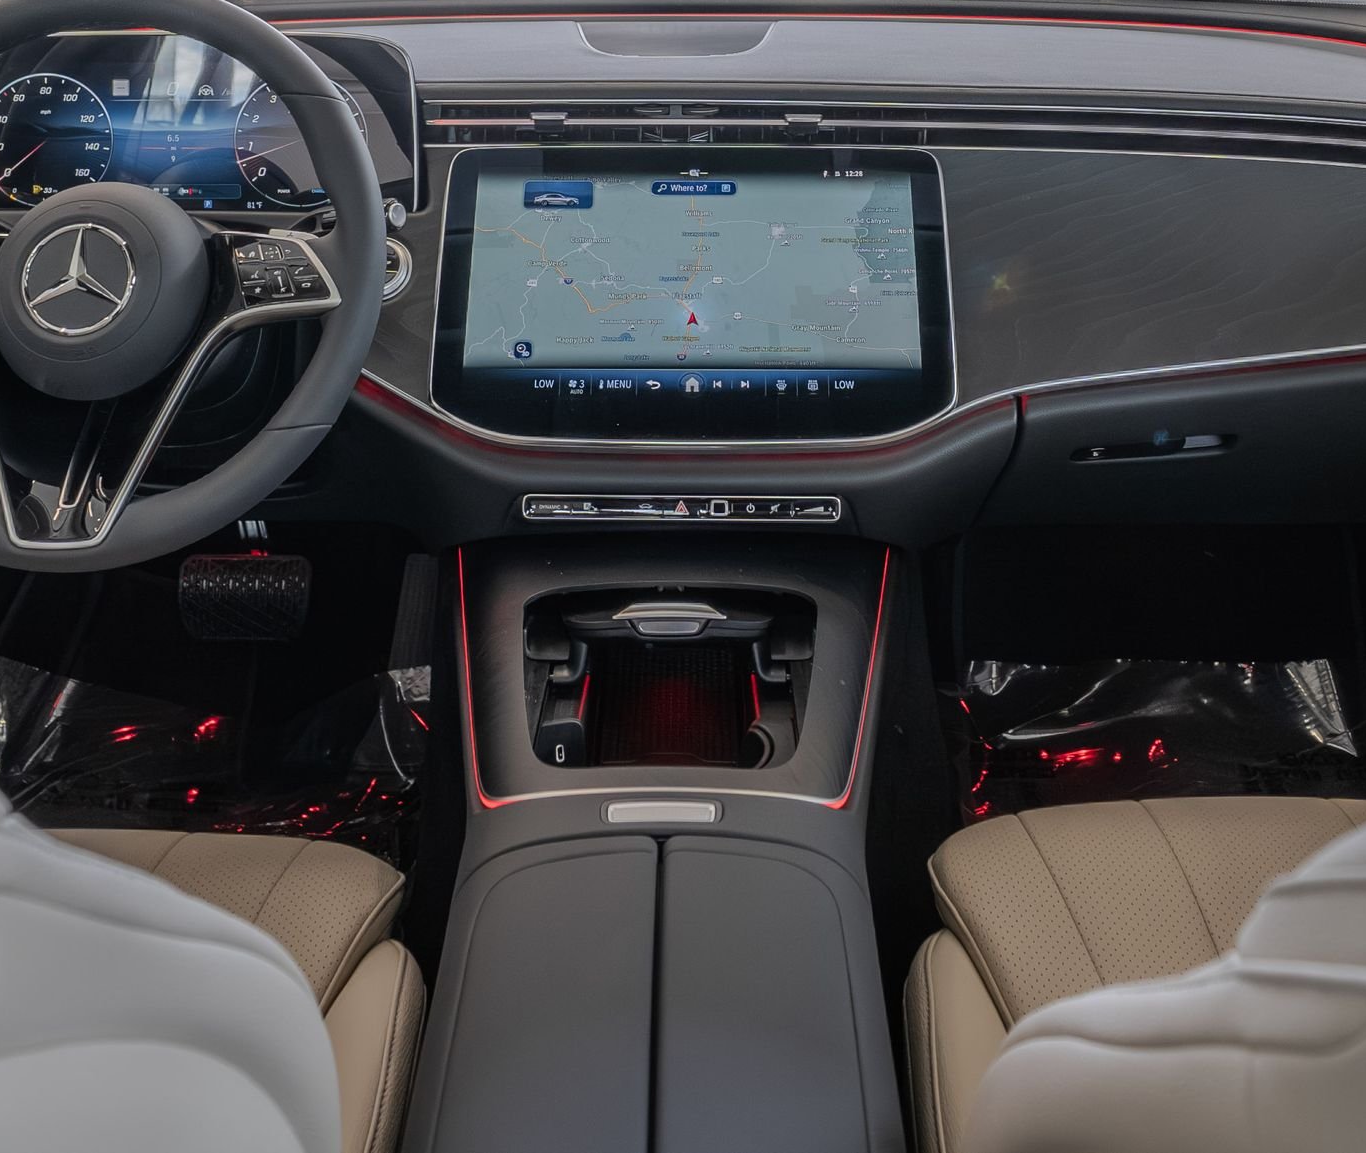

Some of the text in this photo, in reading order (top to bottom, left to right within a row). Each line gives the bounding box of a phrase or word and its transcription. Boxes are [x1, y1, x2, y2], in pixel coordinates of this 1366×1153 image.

[40, 87, 52, 95] 80
[13, 94, 25, 102] 60
[63, 94, 78, 102] 100
[270, 94, 277, 103] 3
[80, 115, 95, 123] 120
[252, 115, 260, 123] 2
[85, 142, 100, 150] 140
[249, 142, 254, 151] 1
[75, 168, 90, 177] 160
[258, 167, 267, 177] 0
[670, 184, 708, 192] Where to?
[534, 380, 554, 389] LOW
[579, 380, 585, 389] 3
[607, 380, 631, 389] MENU
[835, 380, 855, 389] LOW
